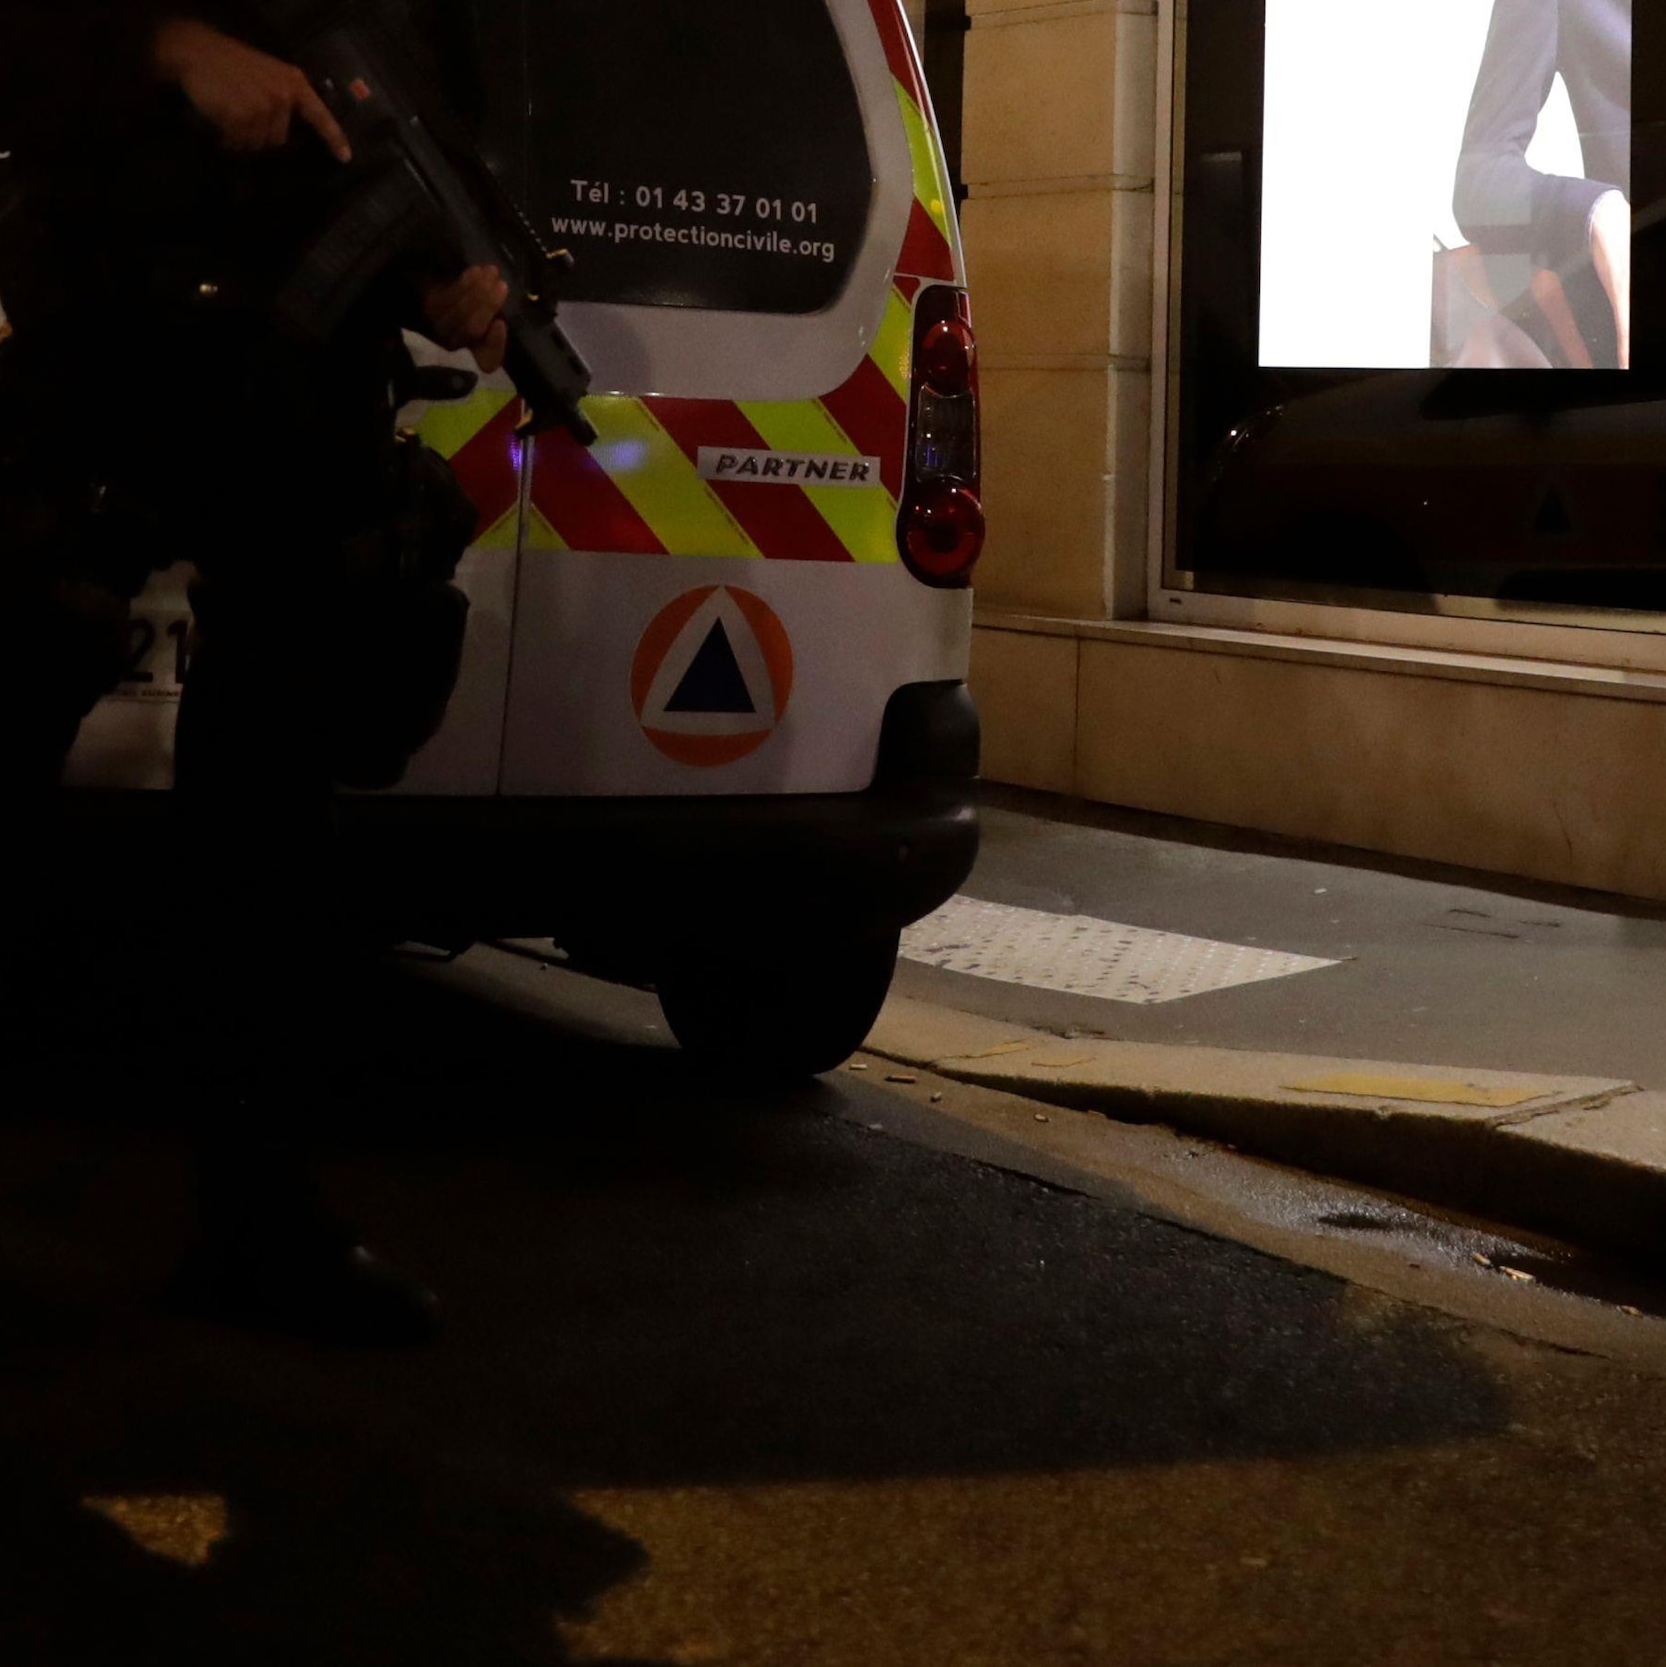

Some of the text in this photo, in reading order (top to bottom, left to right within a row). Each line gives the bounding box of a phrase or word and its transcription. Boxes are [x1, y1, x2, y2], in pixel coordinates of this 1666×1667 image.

[570, 179, 609, 204] Tél
[635, 185, 664, 209] 01
[673, 189, 706, 212] 43
[716, 193, 746, 216] 37
[755, 198, 782, 221] 01
[791, 201, 818, 224] 01
[551, 216, 835, 263] www.protectioncivile.org
[715, 454, 870, 482] PARTNER
